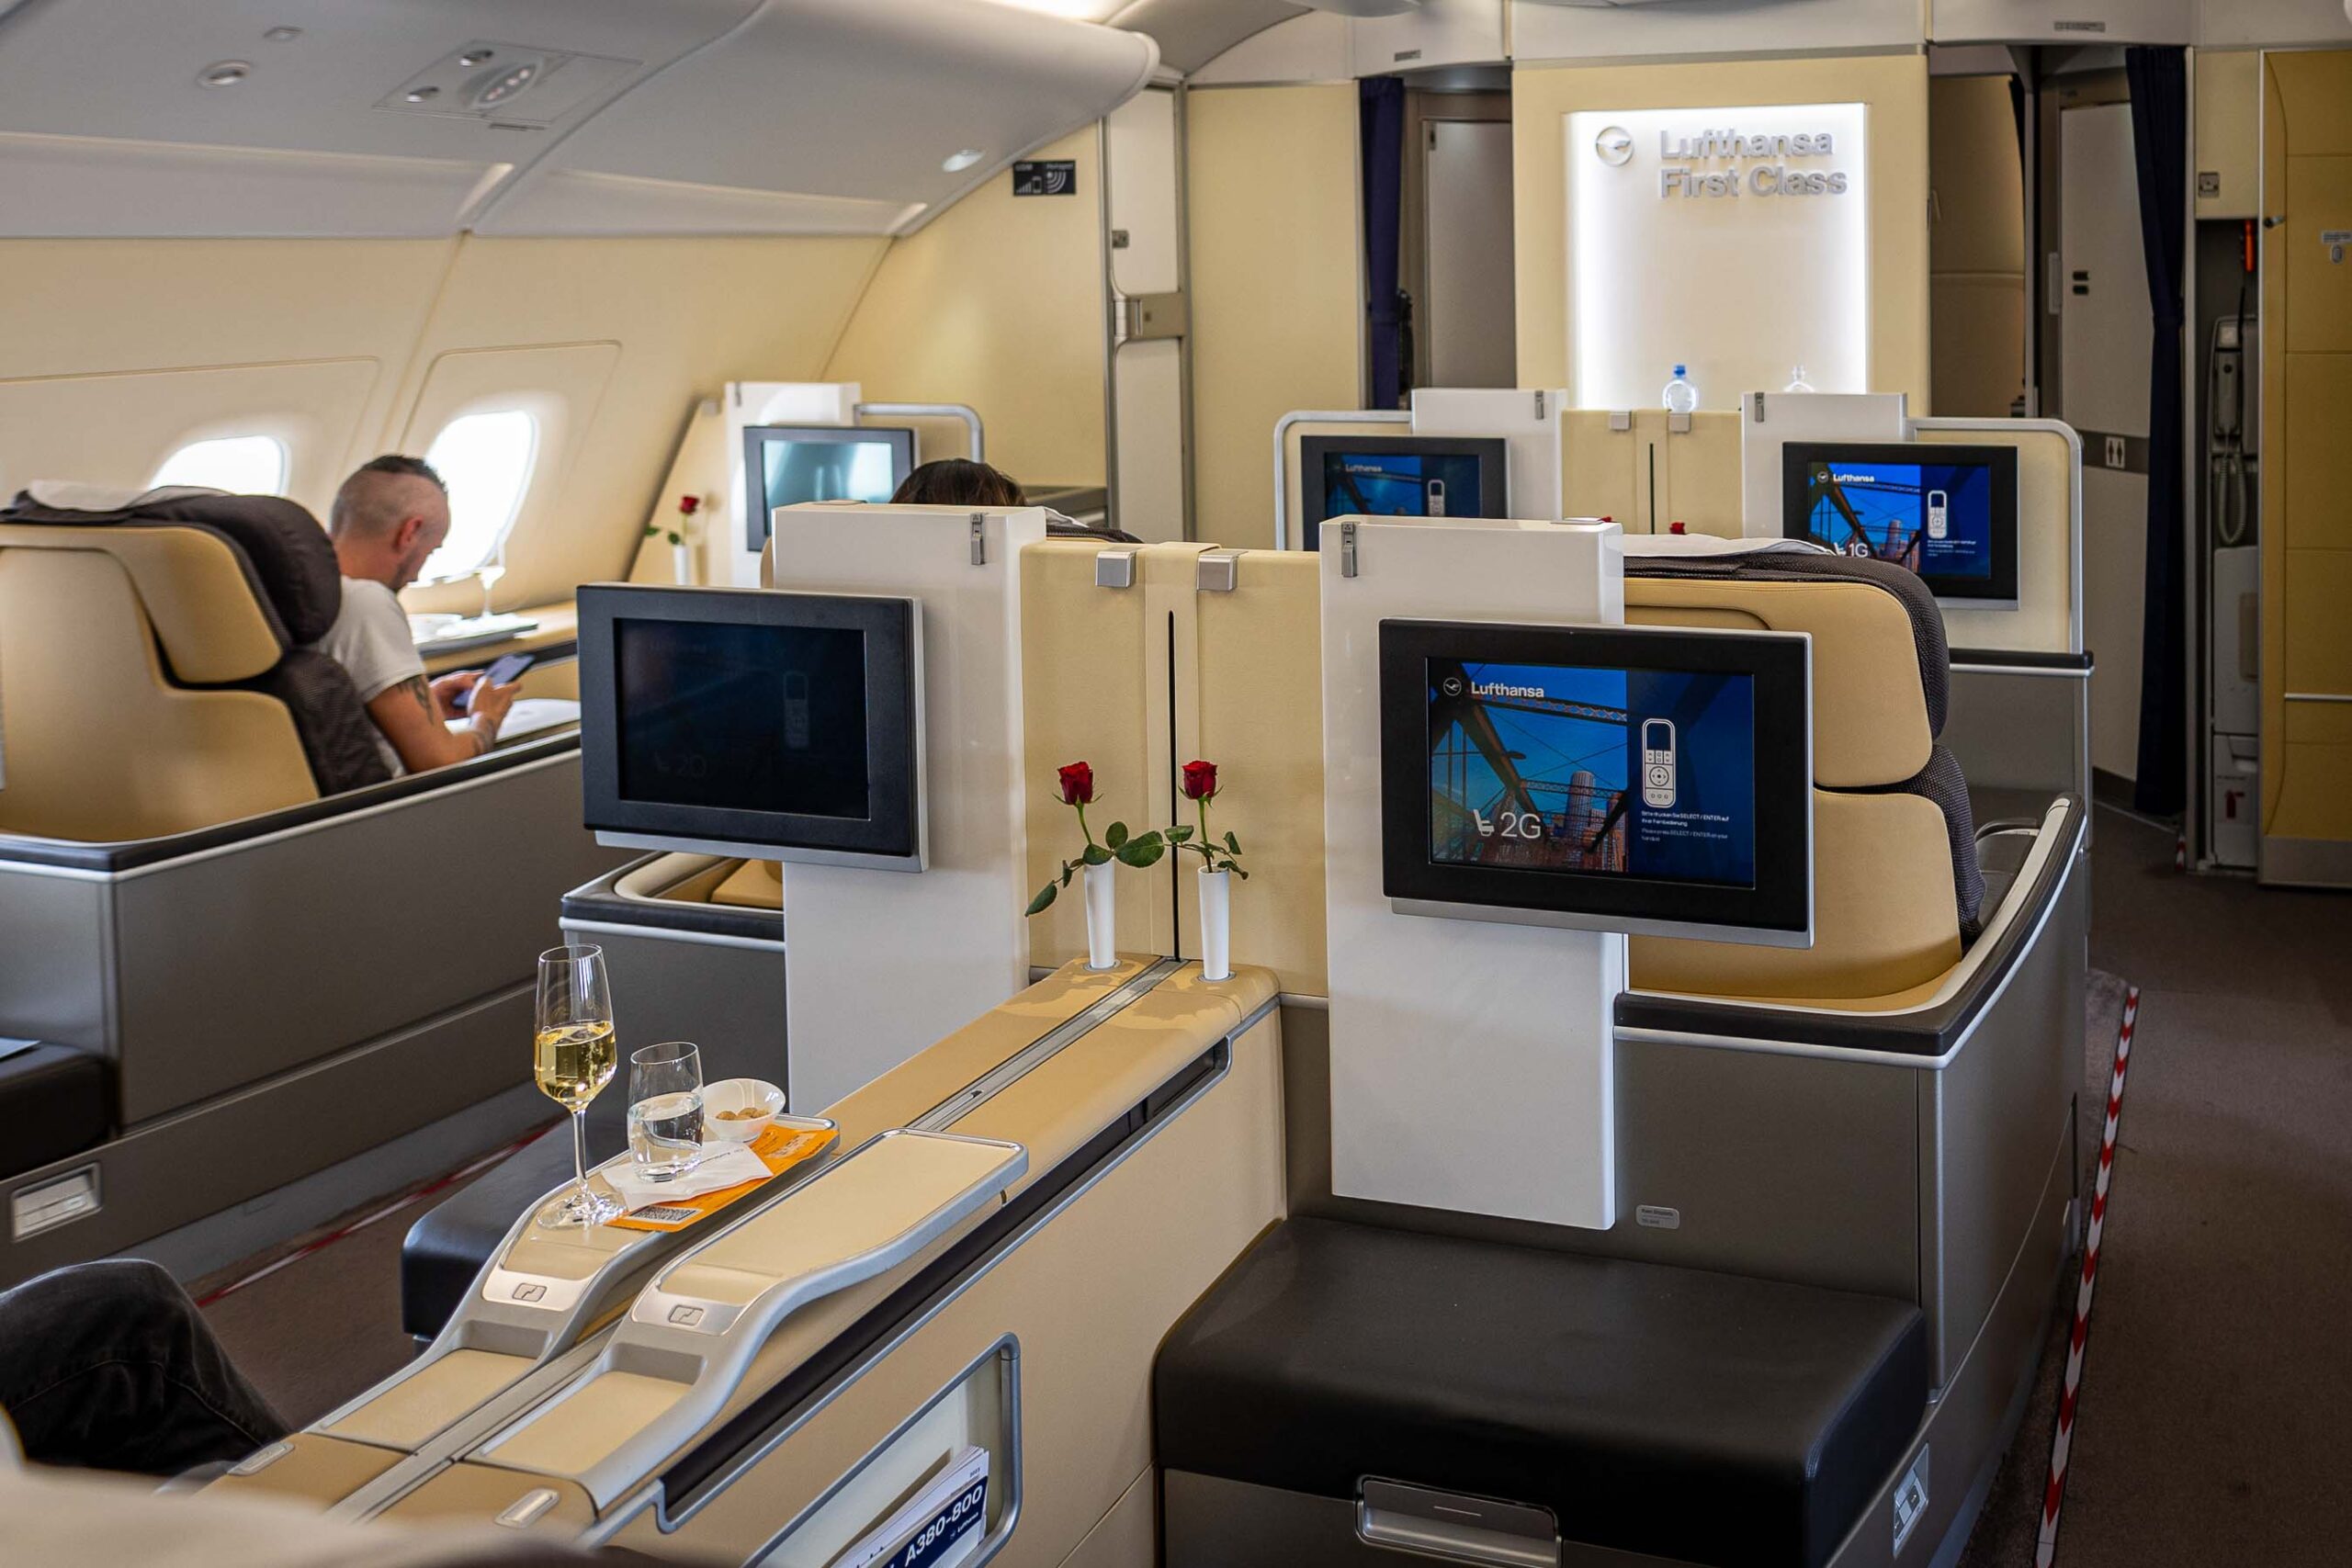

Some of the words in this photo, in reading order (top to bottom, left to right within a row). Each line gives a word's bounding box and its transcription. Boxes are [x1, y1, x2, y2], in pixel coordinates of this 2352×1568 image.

[1659, 127, 1833, 161] Lufthansa
[1660, 167, 1738, 198] First
[1748, 165, 1848, 197] Class
[1833, 473, 1875, 483] Lufthansa
[1849, 543, 1869, 558] 1G
[1470, 681, 1544, 698] Lufthansa
[1500, 813, 1542, 840] 2G
[905, 1484, 984, 1567] A380-800
